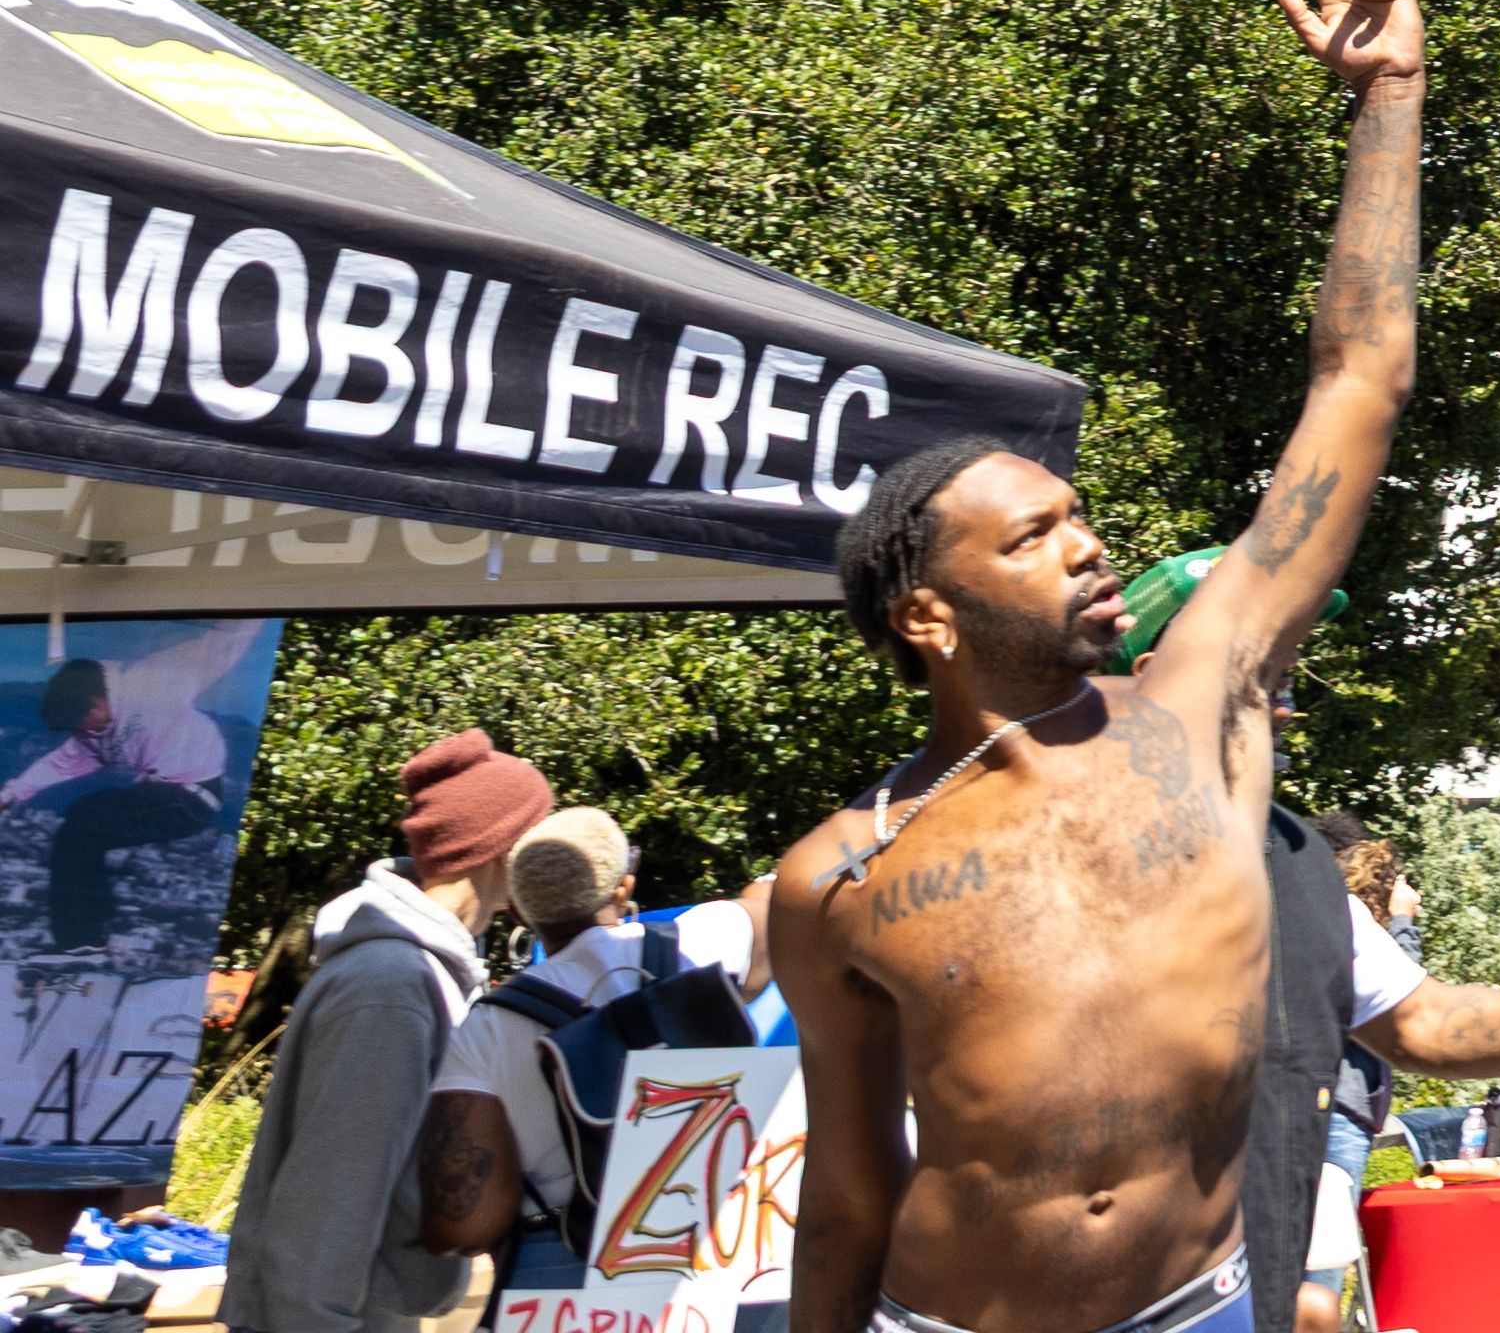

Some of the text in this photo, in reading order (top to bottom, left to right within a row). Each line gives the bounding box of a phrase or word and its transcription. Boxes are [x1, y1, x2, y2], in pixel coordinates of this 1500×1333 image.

[17, 188, 890, 515] MOBILE REC
[0, 1047, 181, 1146] AZ
